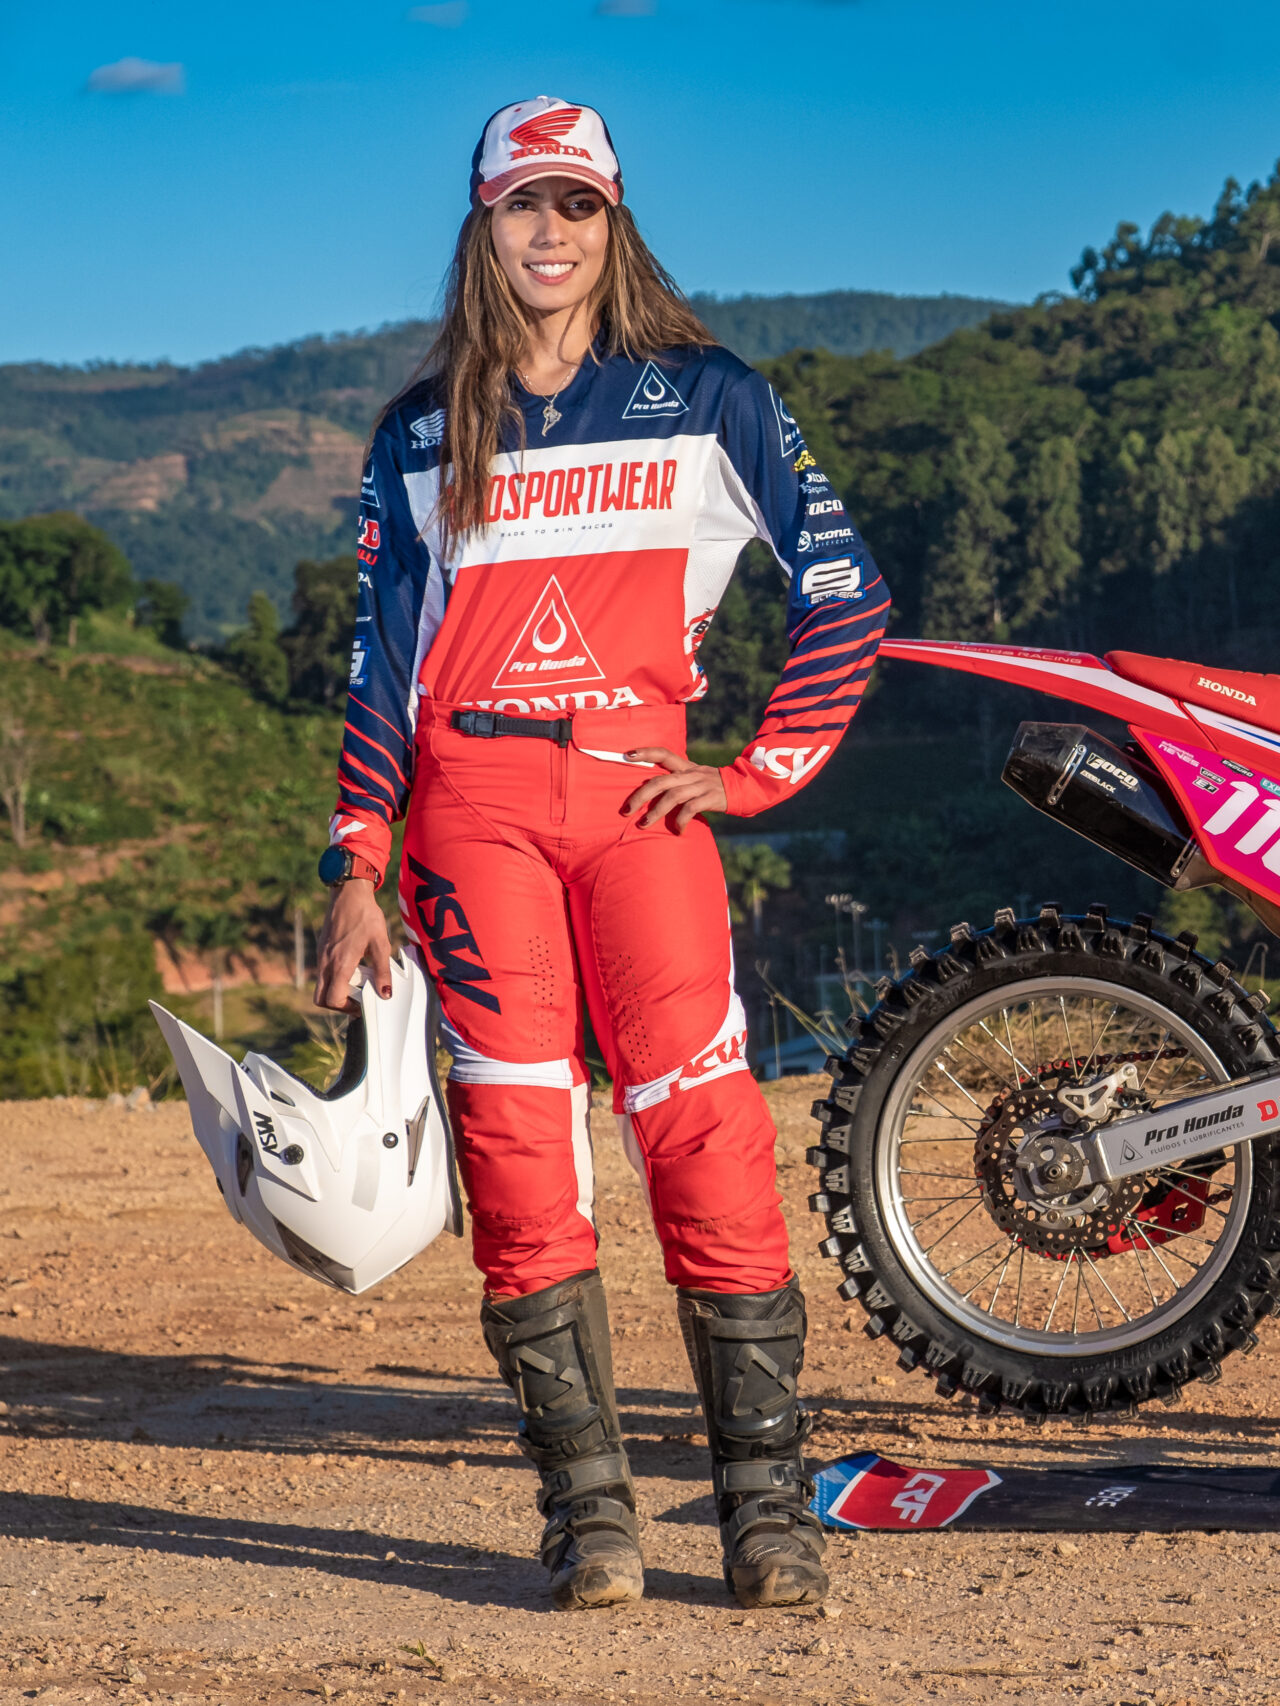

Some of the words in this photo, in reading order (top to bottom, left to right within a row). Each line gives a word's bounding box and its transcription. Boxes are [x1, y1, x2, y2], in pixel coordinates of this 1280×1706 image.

[510, 144, 593, 161] HONDA
[632, 402, 648, 411] Pro
[651, 399, 679, 410] Honda
[806, 500, 844, 516] OCO
[509, 661, 537, 673] Pro
[538, 655, 587, 671] Honda
[1017, 650, 1082, 664] RACING
[1197, 676, 1258, 707] HONDA
[1201, 769, 1223, 784] OPEN
[1221, 759, 1254, 778] ENDURO
[1144, 1127, 1178, 1147] Pro
[1182, 1103, 1245, 1135] Honda
[1189, 1121, 1245, 1144] LUBRIFICANTES
